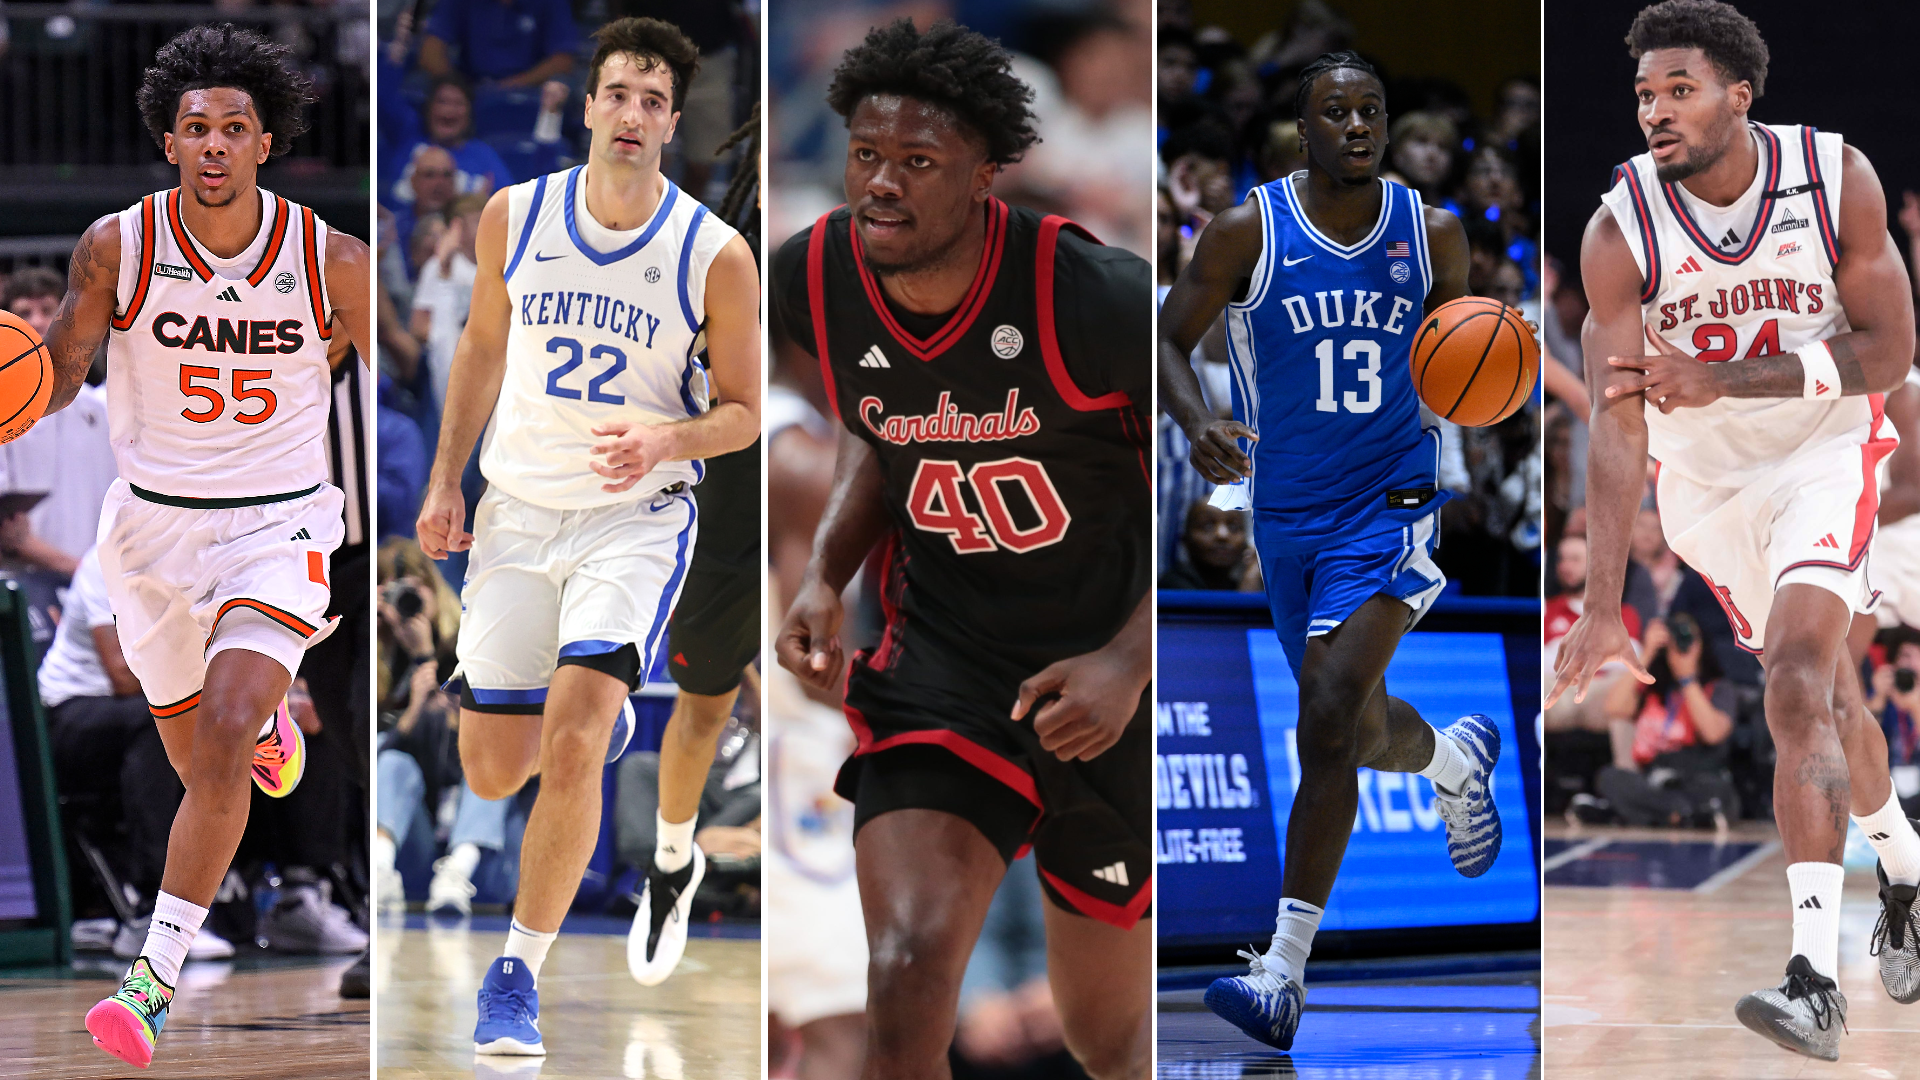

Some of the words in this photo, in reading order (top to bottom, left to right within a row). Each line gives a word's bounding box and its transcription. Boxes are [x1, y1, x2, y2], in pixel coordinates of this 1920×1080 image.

[152, 311, 304, 354] CANES
[521, 291, 660, 349] KENTUCKY
[1281, 289, 1413, 335] DUKE
[1660, 293, 1702, 332] ST.
[1708, 278, 1824, 319] JOHN'S
[997, 336, 1019, 344] ACC
[1692, 318, 1786, 364] 24
[179, 363, 277, 424] 55
[545, 336, 627, 405] 22
[1315, 339, 1382, 414] 13
[859, 388, 1041, 445] Cardinals
[906, 456, 1072, 554] 40
[1173, 702, 1212, 736] THE
[1157, 753, 1251, 809] DEVILS
